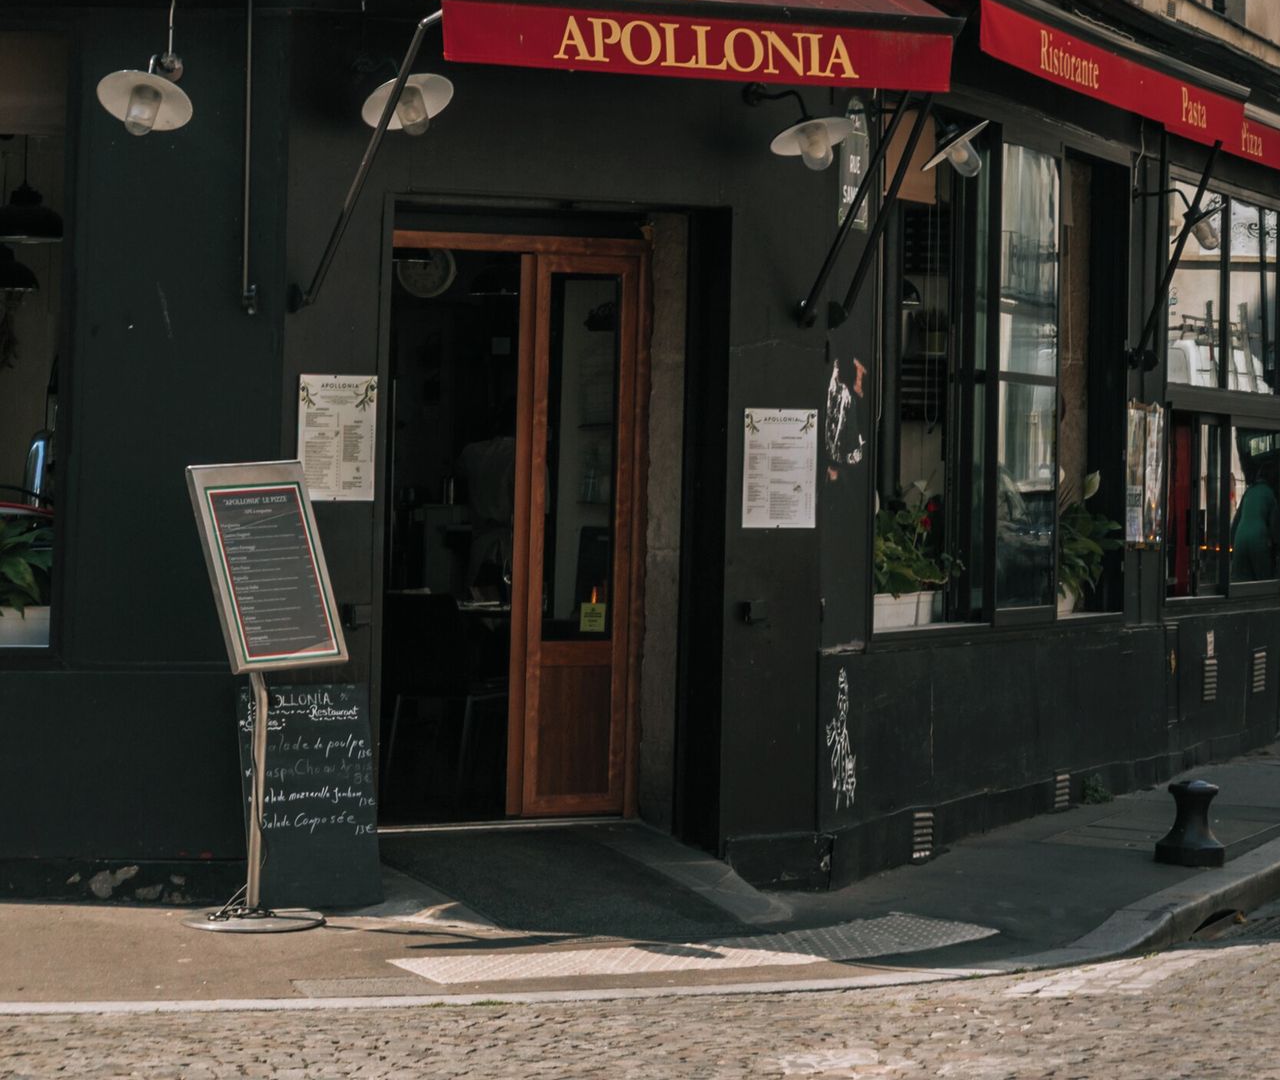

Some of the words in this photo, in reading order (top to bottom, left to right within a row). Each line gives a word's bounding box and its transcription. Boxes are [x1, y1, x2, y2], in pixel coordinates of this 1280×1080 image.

[553, 15, 860, 79] APOLLONIA
[1040, 29, 1099, 90] Ristorante
[1181, 87, 1207, 129] Pasta
[1241, 121, 1263, 158] Pizza
[849, 154, 861, 174] RUE
[308, 704, 360, 717] Restaurant
[267, 733, 310, 751] alade
[325, 733, 364, 759] poulpe
